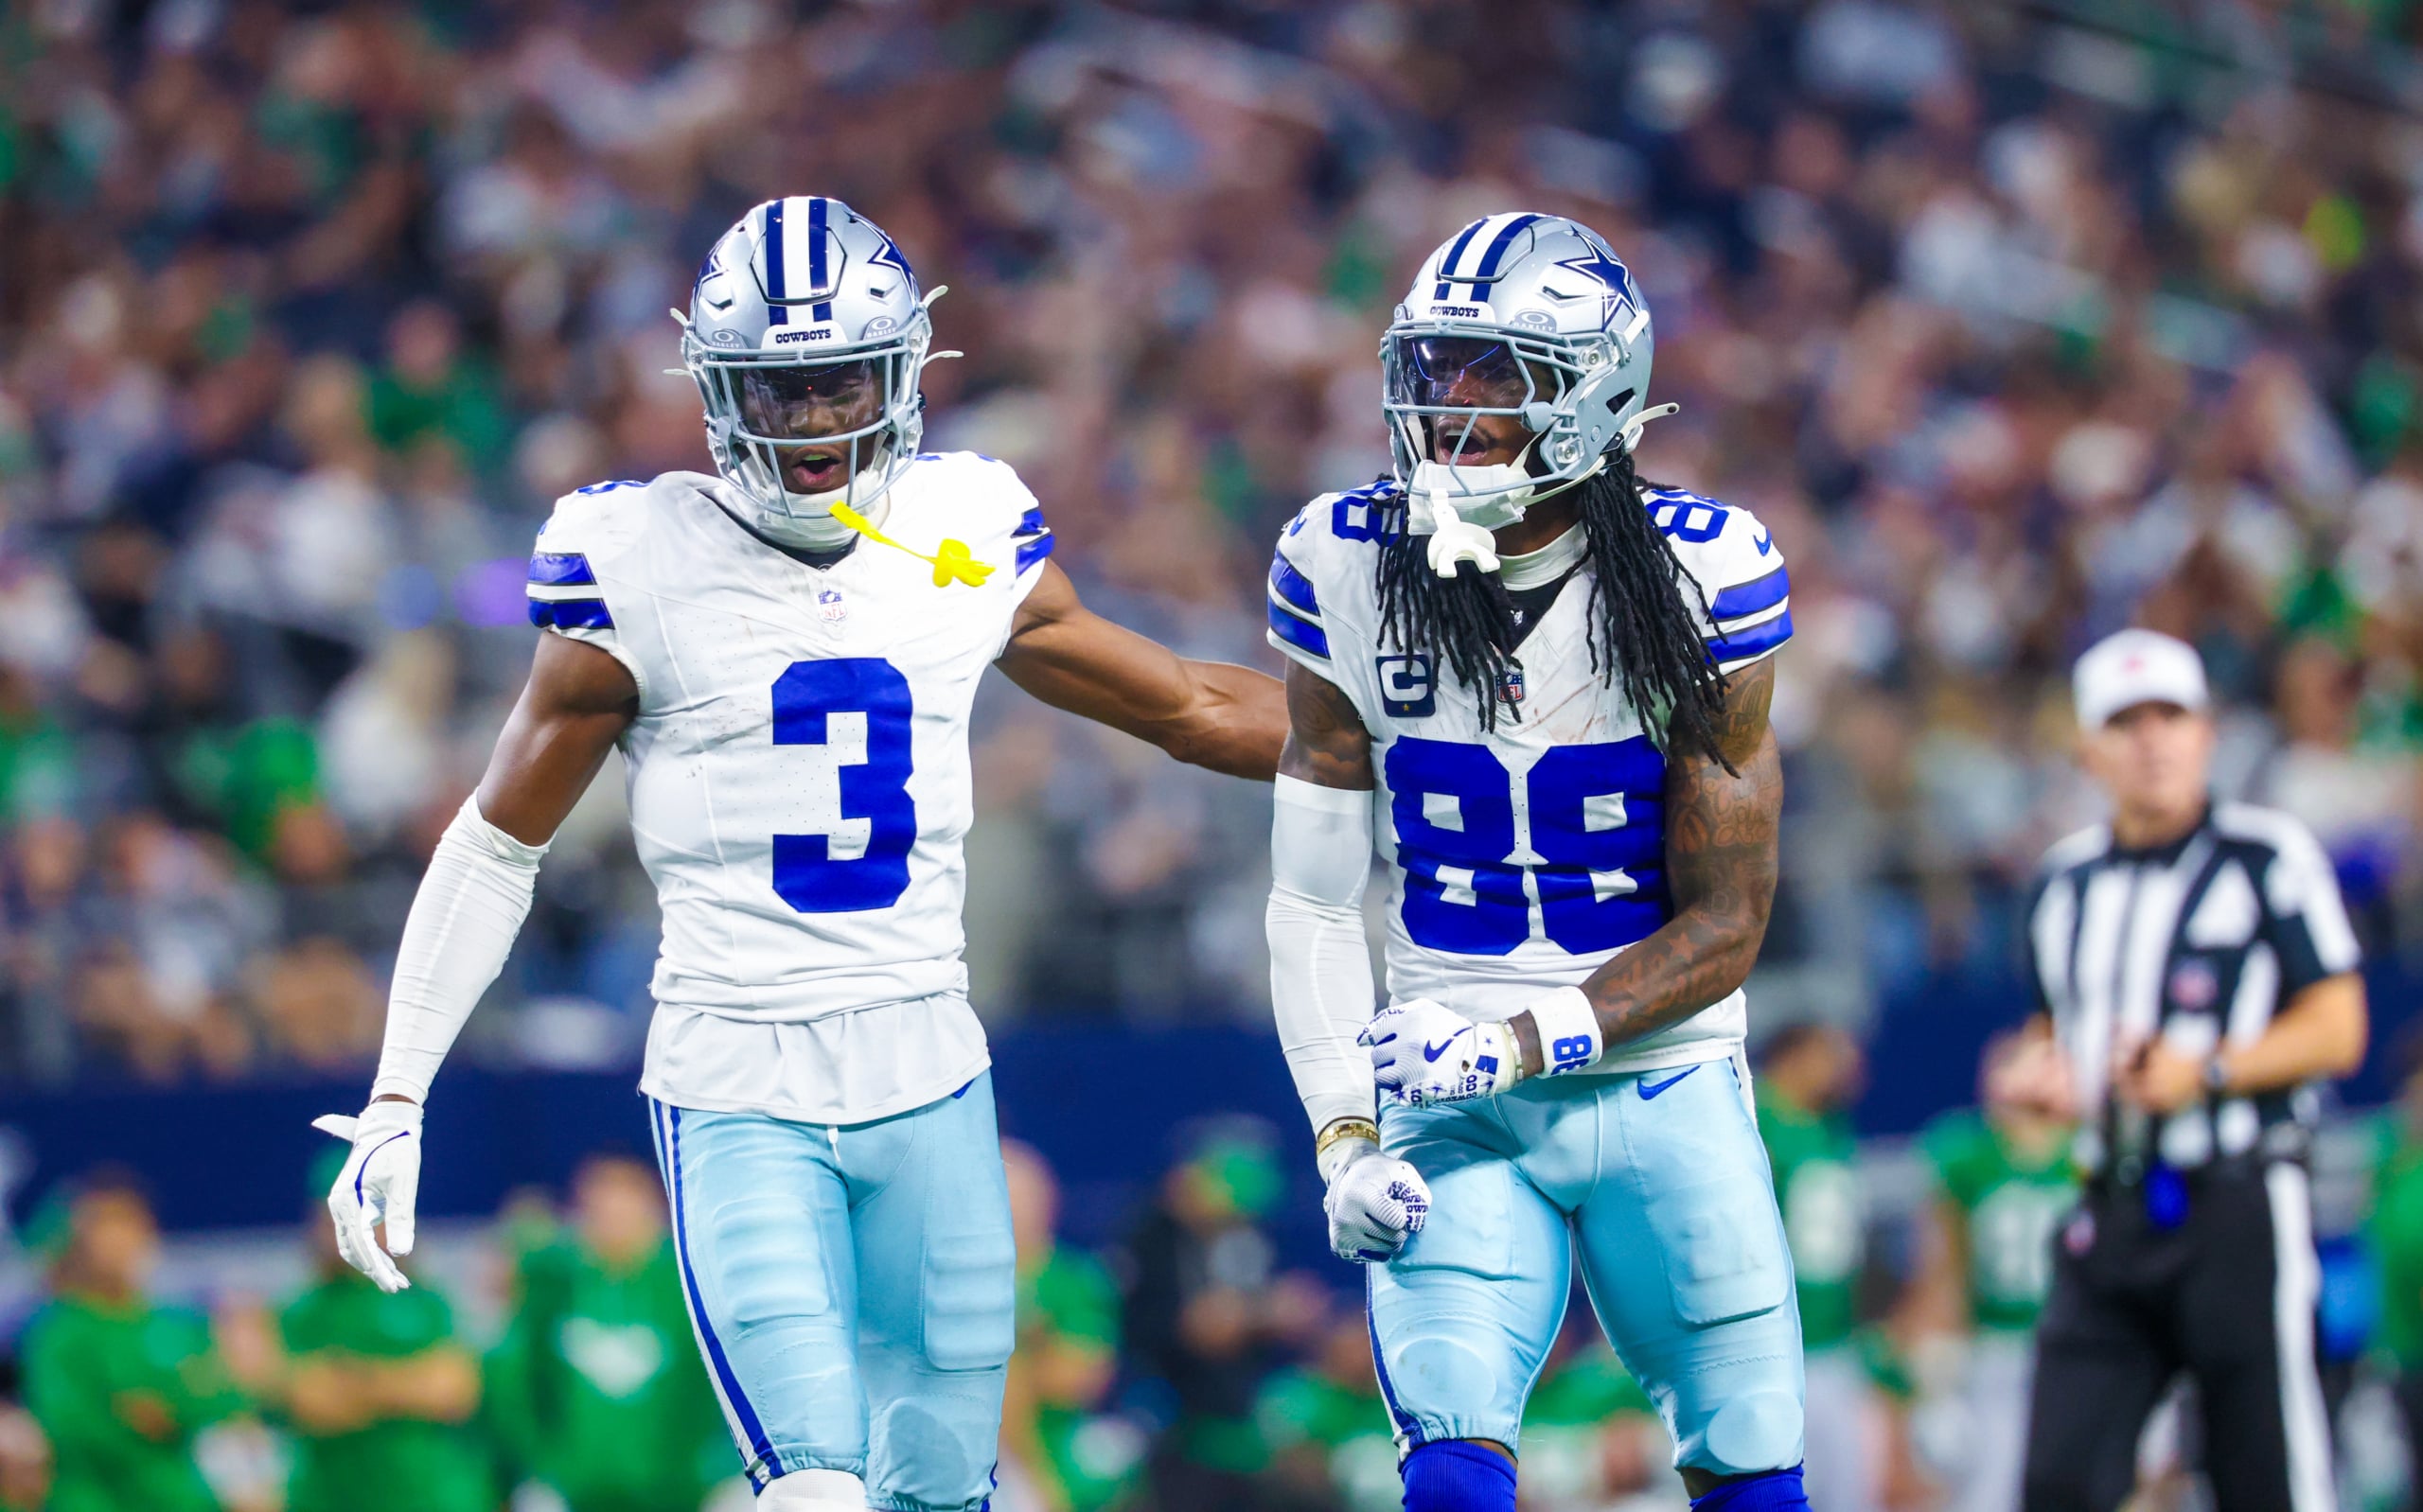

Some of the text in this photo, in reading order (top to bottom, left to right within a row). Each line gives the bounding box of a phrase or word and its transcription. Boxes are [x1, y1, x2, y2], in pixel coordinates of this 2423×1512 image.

[1430, 306, 1479, 318] COWBOYS
[775, 328, 831, 343] COWBOYS
[824, 603, 845, 619] NFL
[1380, 659, 1428, 702] C
[771, 658, 917, 913] 3
[1384, 734, 1668, 956] 88
